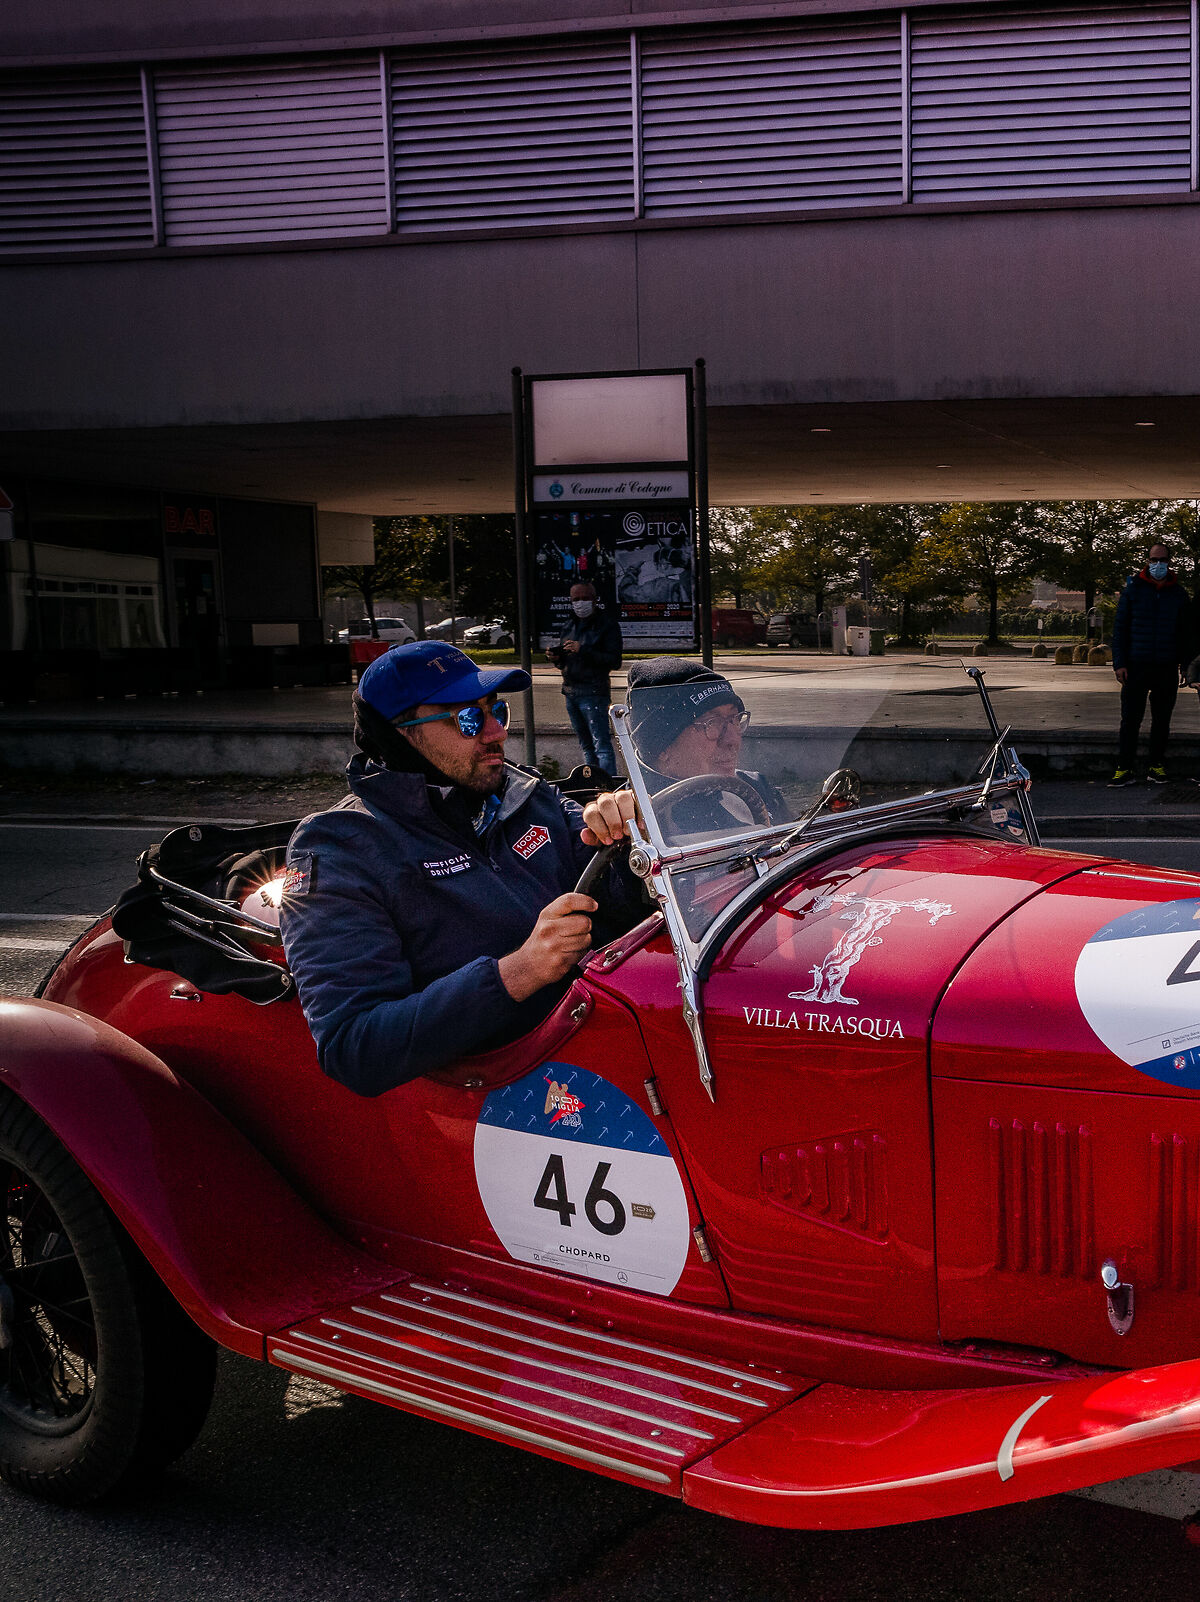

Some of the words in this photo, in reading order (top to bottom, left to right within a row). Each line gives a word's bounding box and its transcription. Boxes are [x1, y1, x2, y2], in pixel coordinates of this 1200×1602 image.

[570, 482, 614, 495] Comune
[615, 482, 627, 493] di
[629, 481, 672, 497] Codogno
[164, 506, 216, 536] BAR
[647, 521, 688, 536] ETICA
[516, 830, 537, 850] 1000
[522, 834, 546, 857] MIGLIA
[423, 853, 471, 869] OFFICIAL
[430, 862, 471, 877] DRIVER
[742, 1006, 800, 1030] VILLA
[804, 1012, 905, 1041] TRASQUA
[550, 1095, 579, 1105] 1000
[551, 1102, 580, 1113] MIGLIA
[533, 1153, 626, 1236] 46
[559, 1244, 611, 1263] CHOPARD
